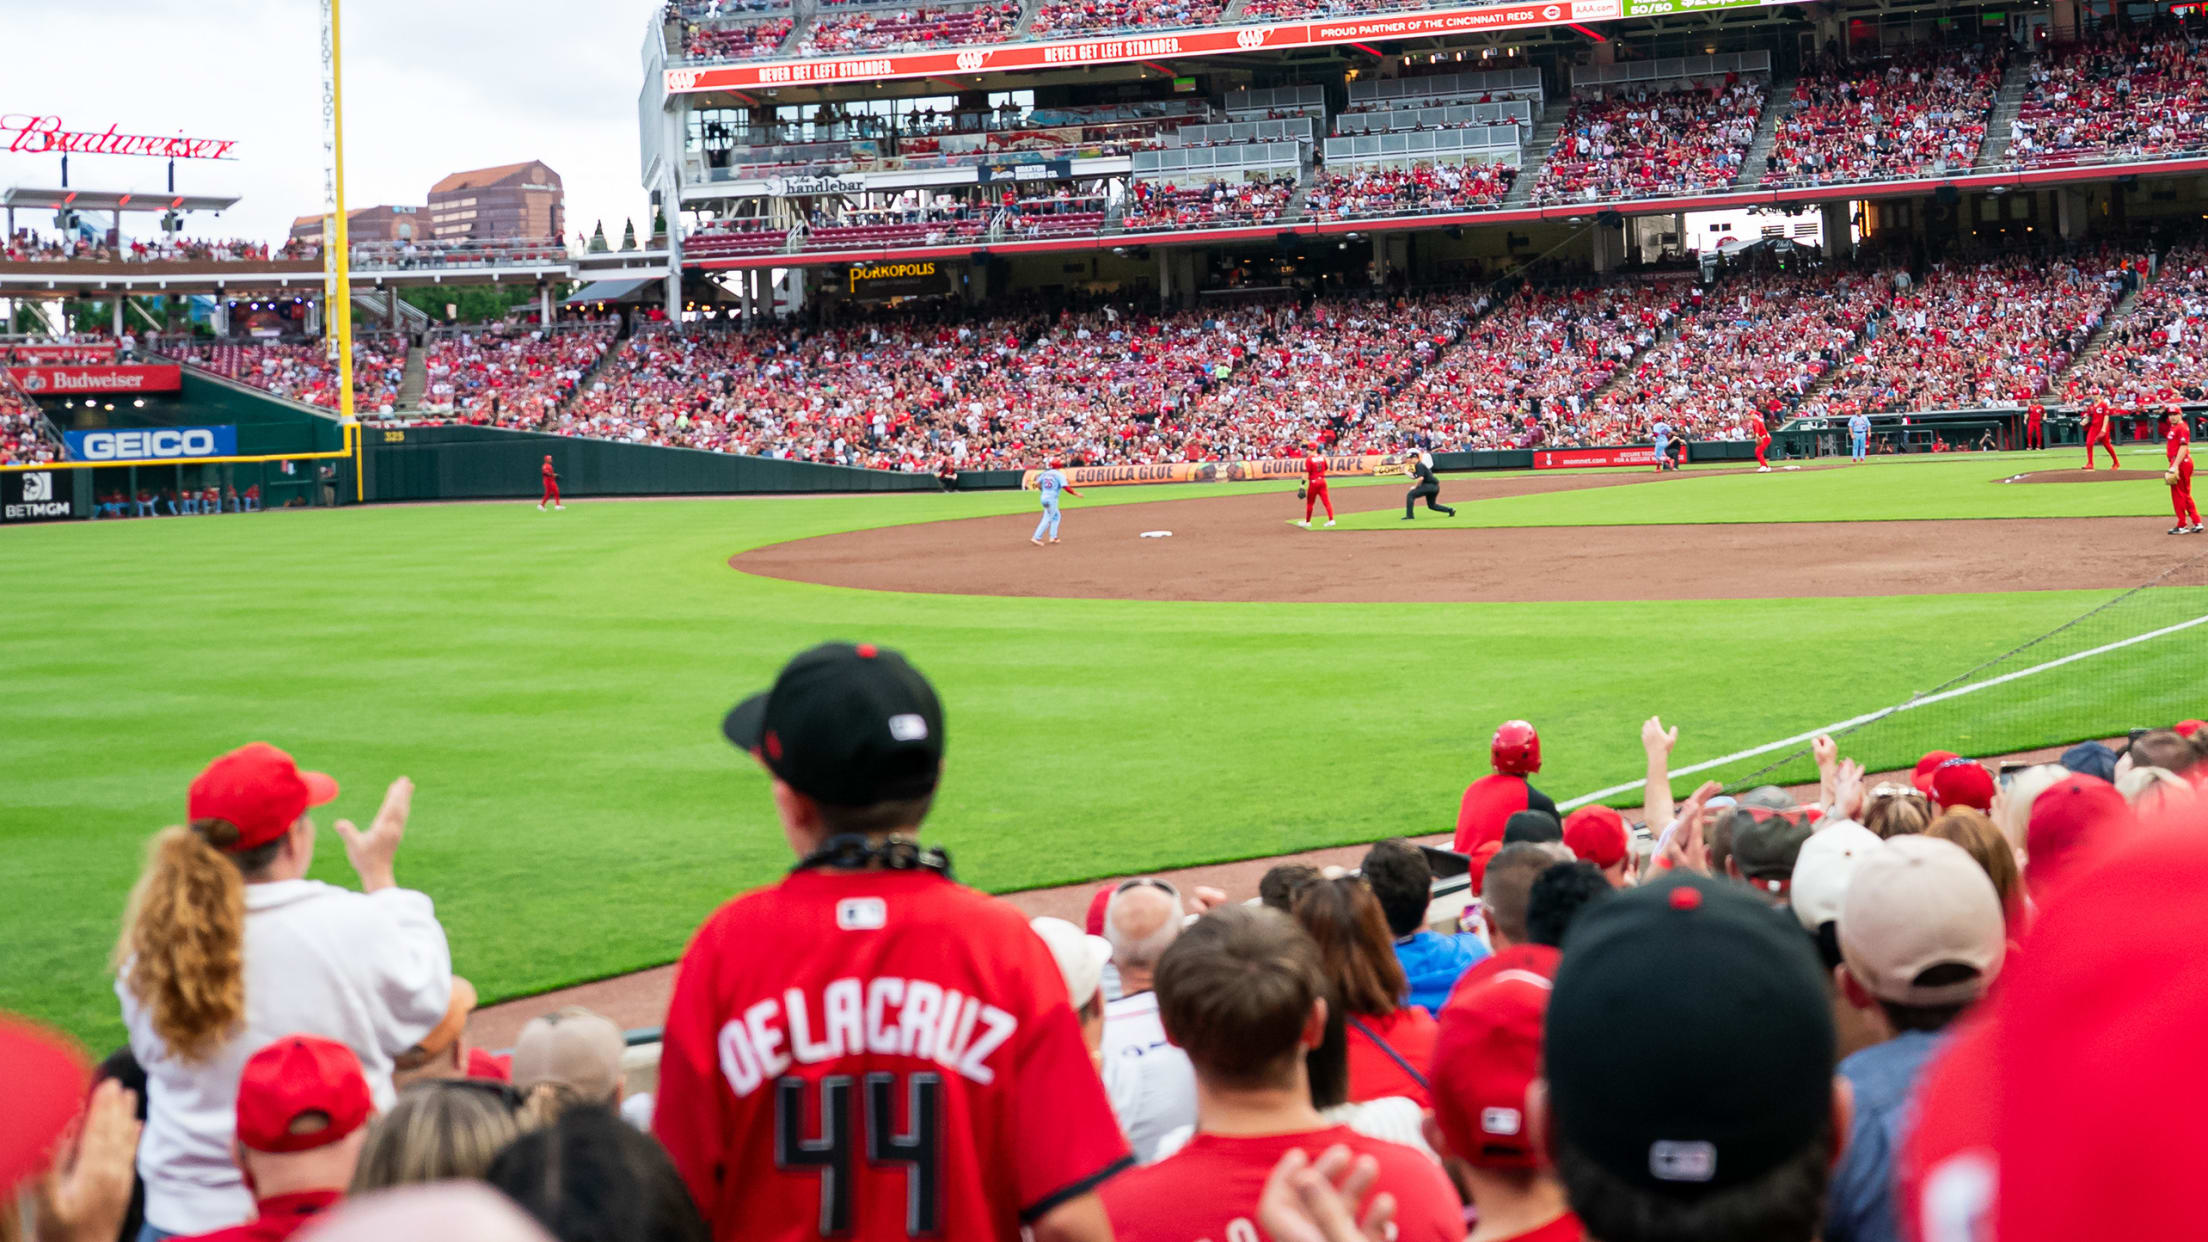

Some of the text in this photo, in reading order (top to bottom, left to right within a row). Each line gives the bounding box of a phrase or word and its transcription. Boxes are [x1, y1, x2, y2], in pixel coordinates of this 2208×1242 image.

[1630, 3, 1672, 14] 50/50
[1321, 11, 1534, 37] PROUD PARTNER OF THE CINCINNATI REDS
[1045, 38, 1182, 62] NEVER GET LEFT STRANDED.
[759, 60, 895, 82] NEVER GET LEFT STRANDED.
[1, 113, 235, 159] Budweiser
[785, 178, 864, 195] handlebar
[849, 262, 935, 293] PORKOPOLIS
[53, 371, 144, 389] Budweiser
[83, 429, 214, 460] GEICO
[384, 431, 405, 442] 325
[1075, 464, 1174, 483] GORILLA GLUE
[1262, 458, 1307, 474] GORIL
[1328, 457, 1363, 471] TAPE
[5, 502, 70, 518] BETMGM
[775, 1071, 942, 1238] 44
